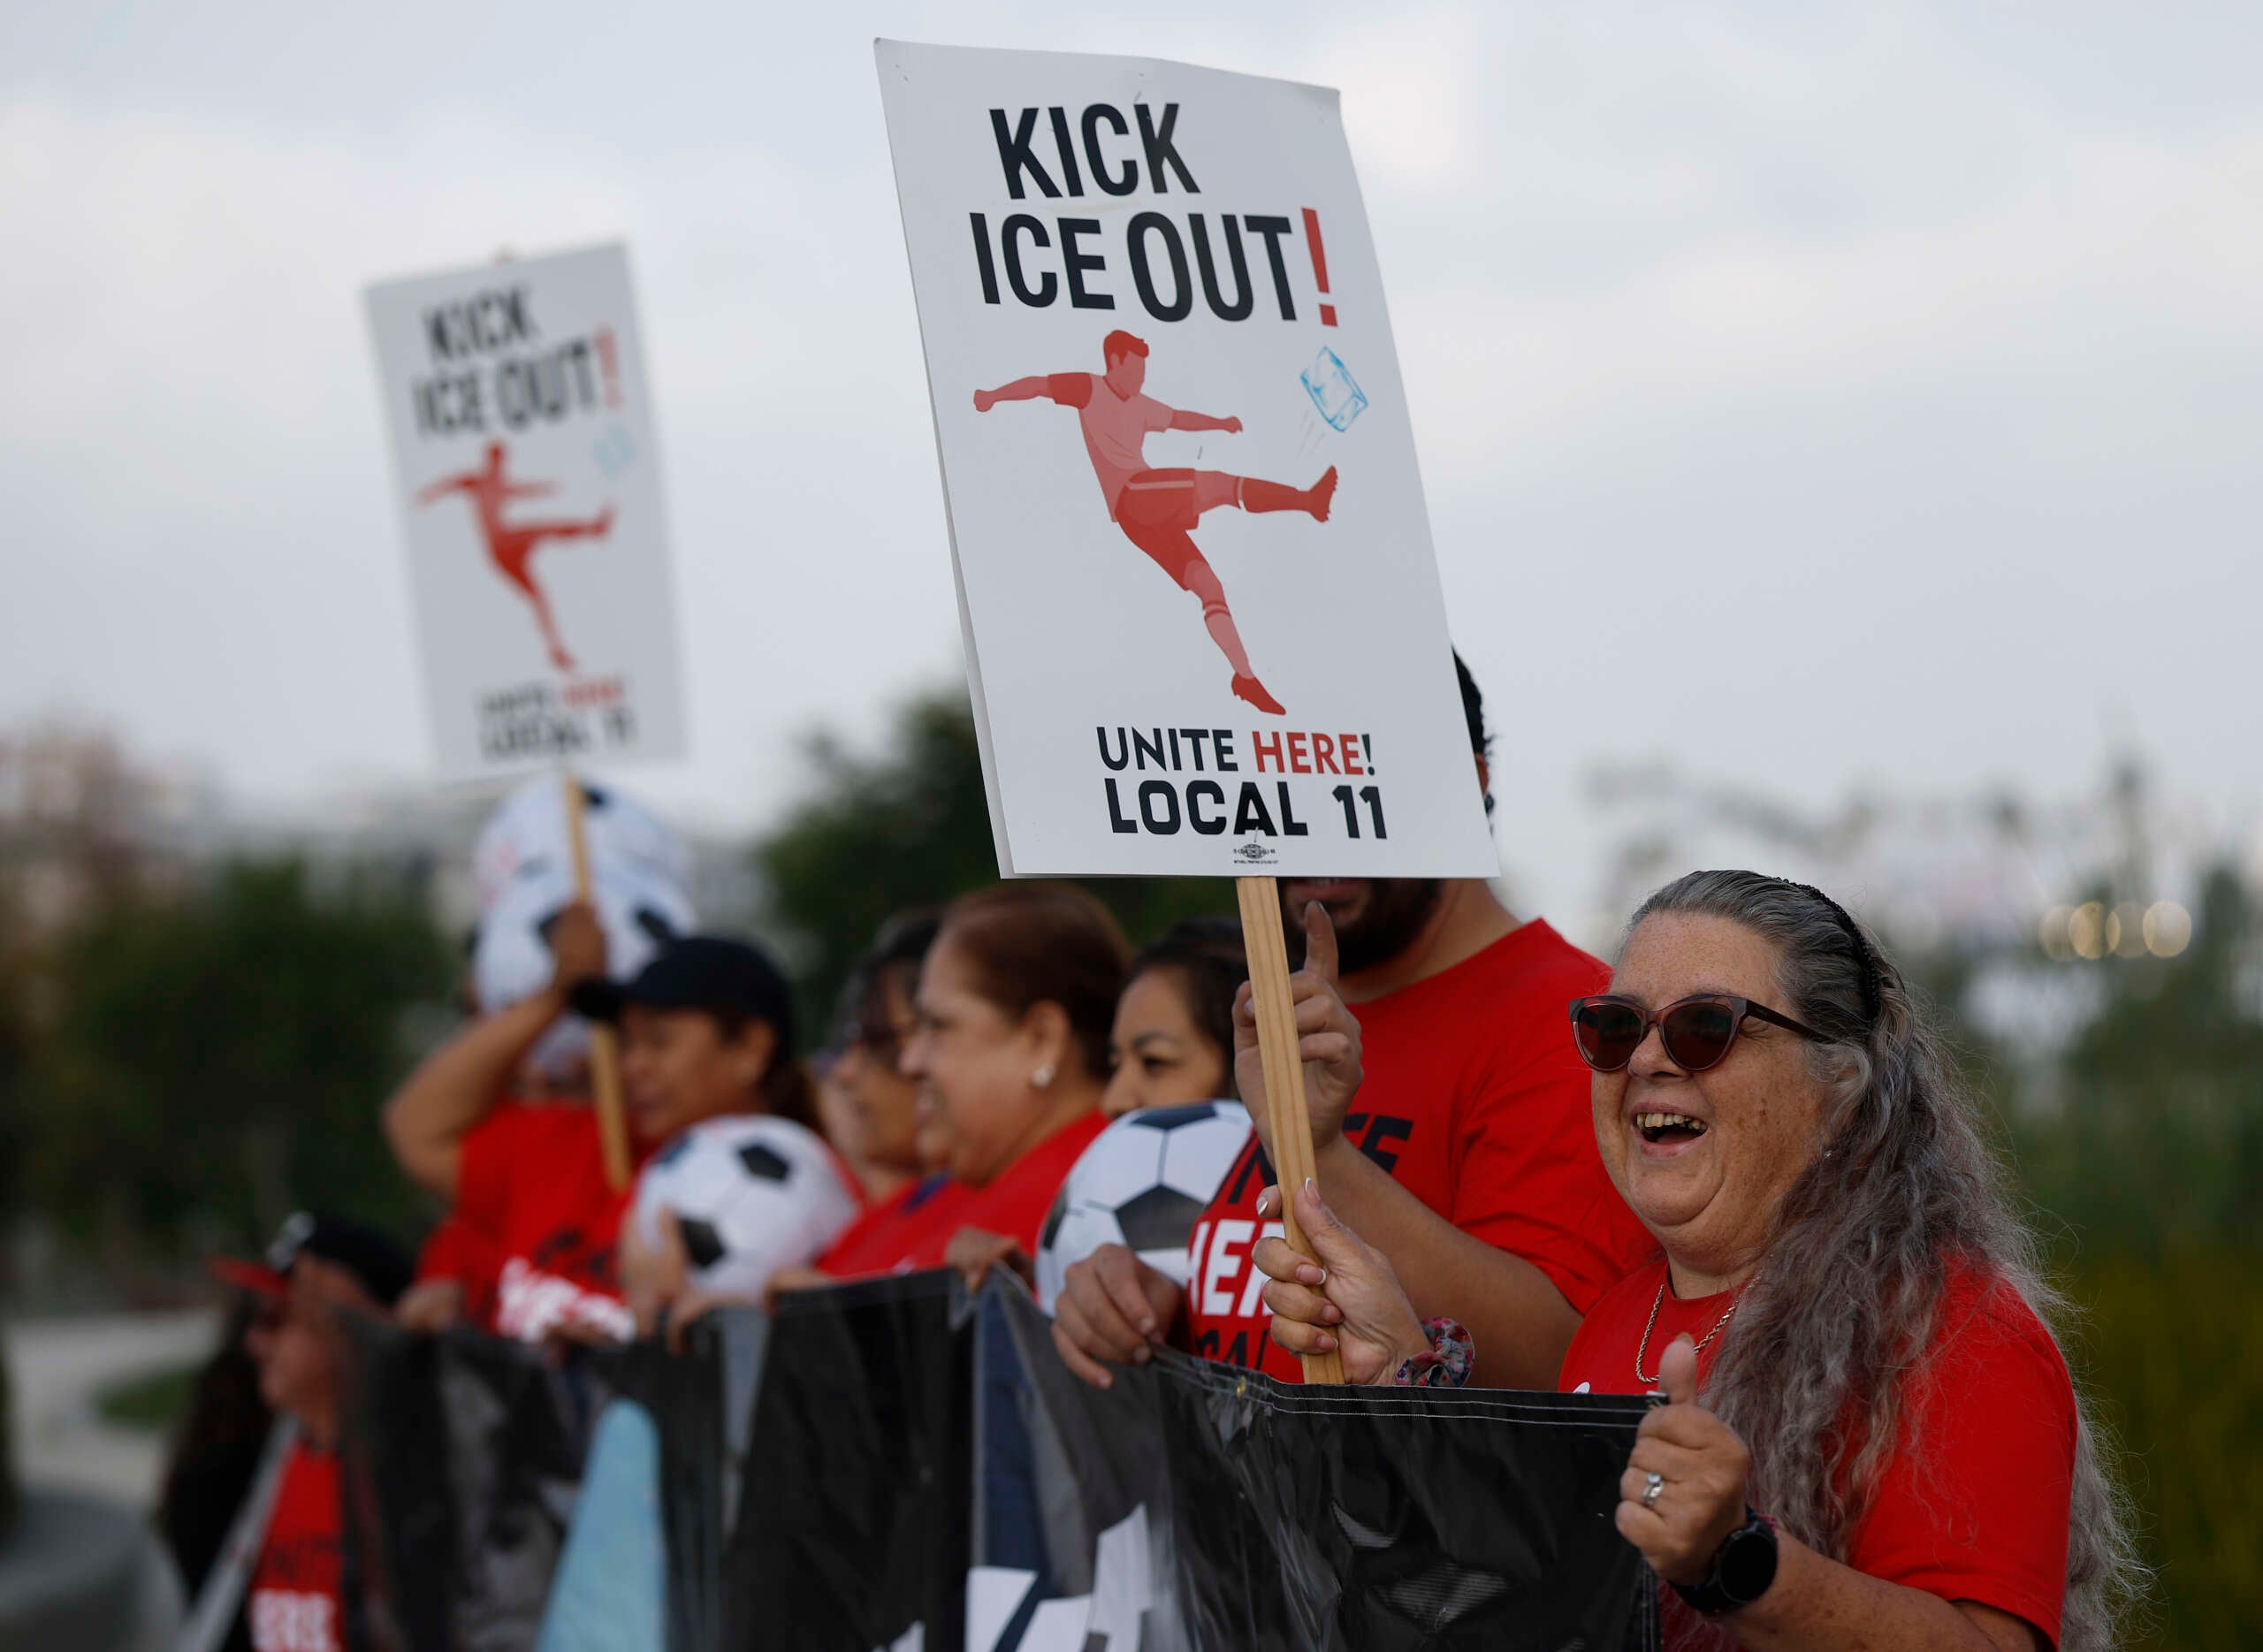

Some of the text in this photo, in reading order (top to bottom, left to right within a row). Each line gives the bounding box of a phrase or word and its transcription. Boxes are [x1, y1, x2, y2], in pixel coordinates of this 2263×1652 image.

[989, 103, 1201, 200] KICK
[970, 208, 1338, 327] ICE OUT!
[423, 285, 537, 362] KICK
[413, 368, 488, 437] ICE
[1096, 727, 1375, 776] UNITE HERE!
[1104, 778, 1388, 840] LOCAL 11
